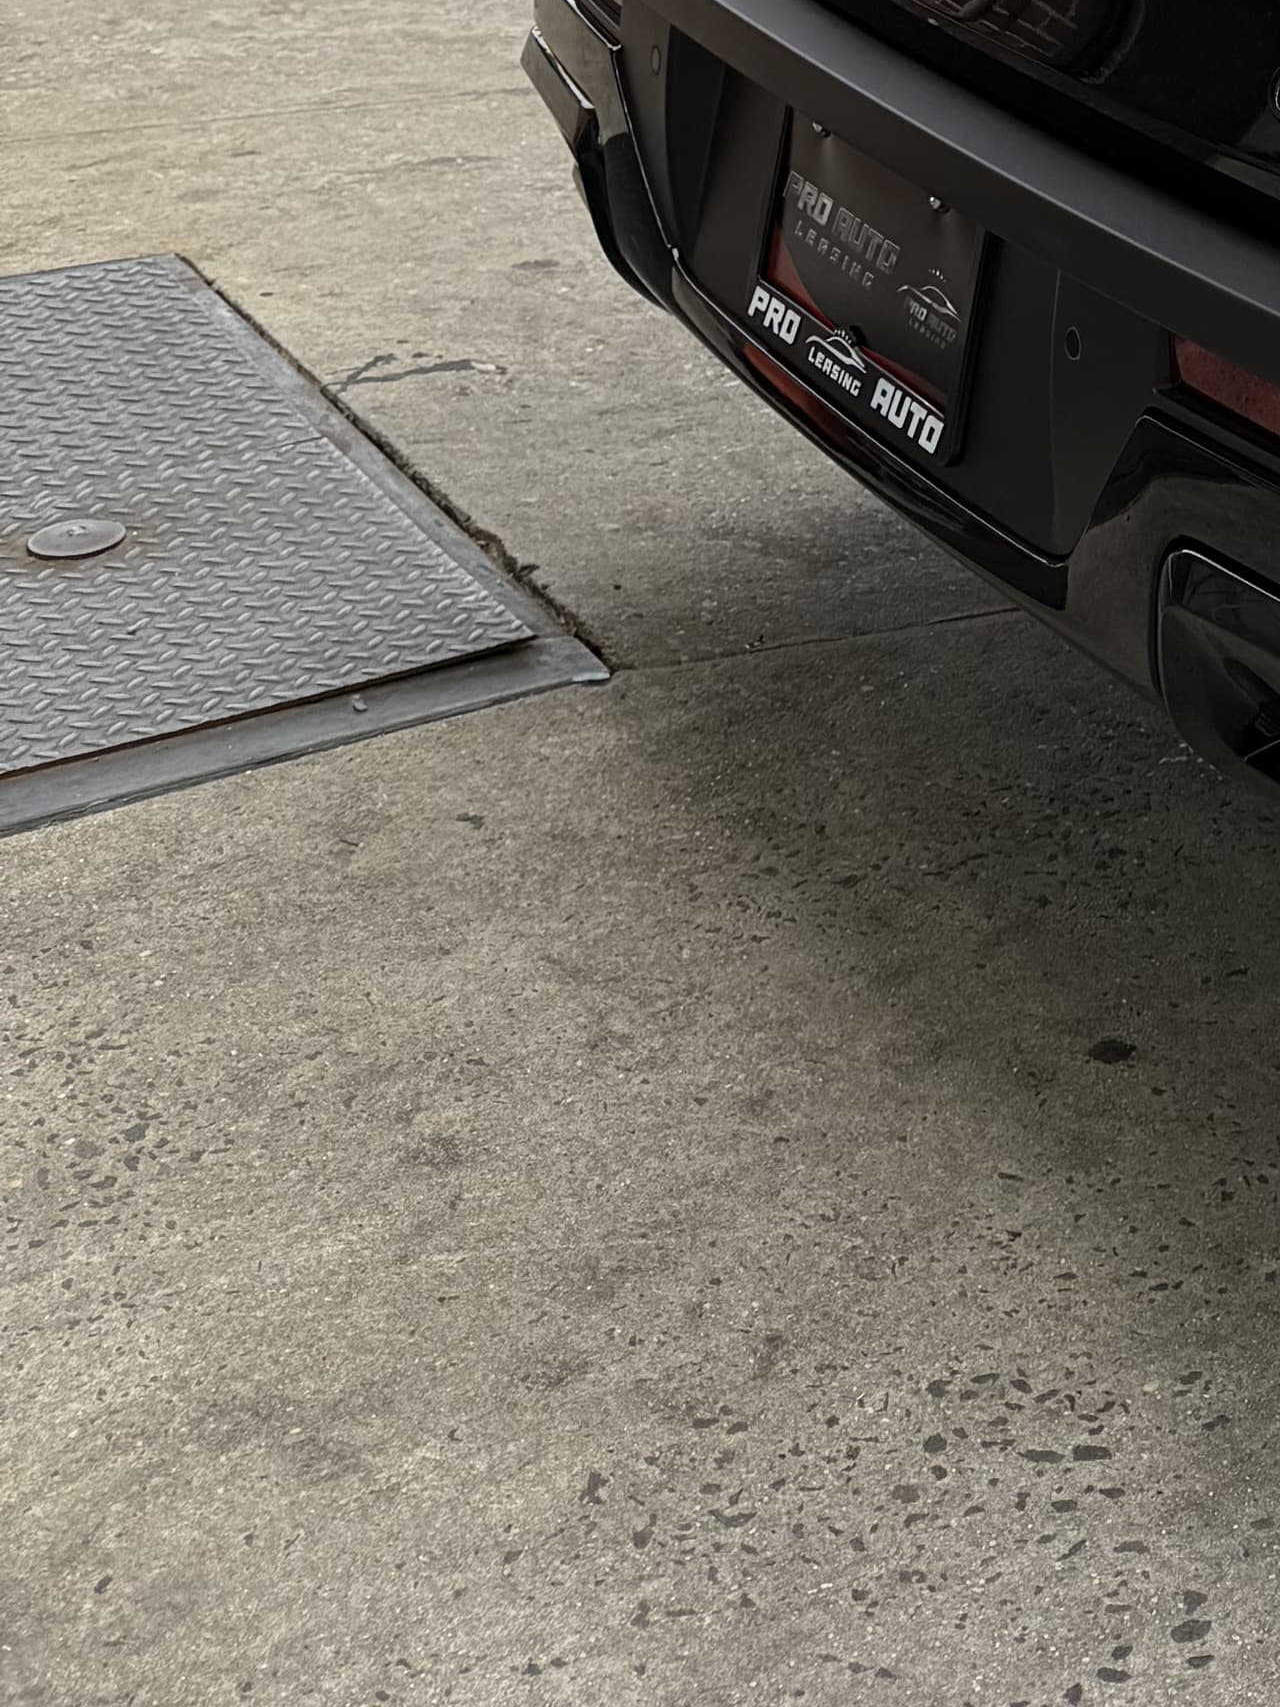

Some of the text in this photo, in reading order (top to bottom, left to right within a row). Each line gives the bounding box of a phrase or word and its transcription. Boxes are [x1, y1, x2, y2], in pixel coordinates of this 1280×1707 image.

[783, 170, 901, 275] PRO AUTO
[794, 220, 875, 291] LEASING
[747, 285, 945, 455] PRO AUTO
[808, 346, 862, 398] LEASING
